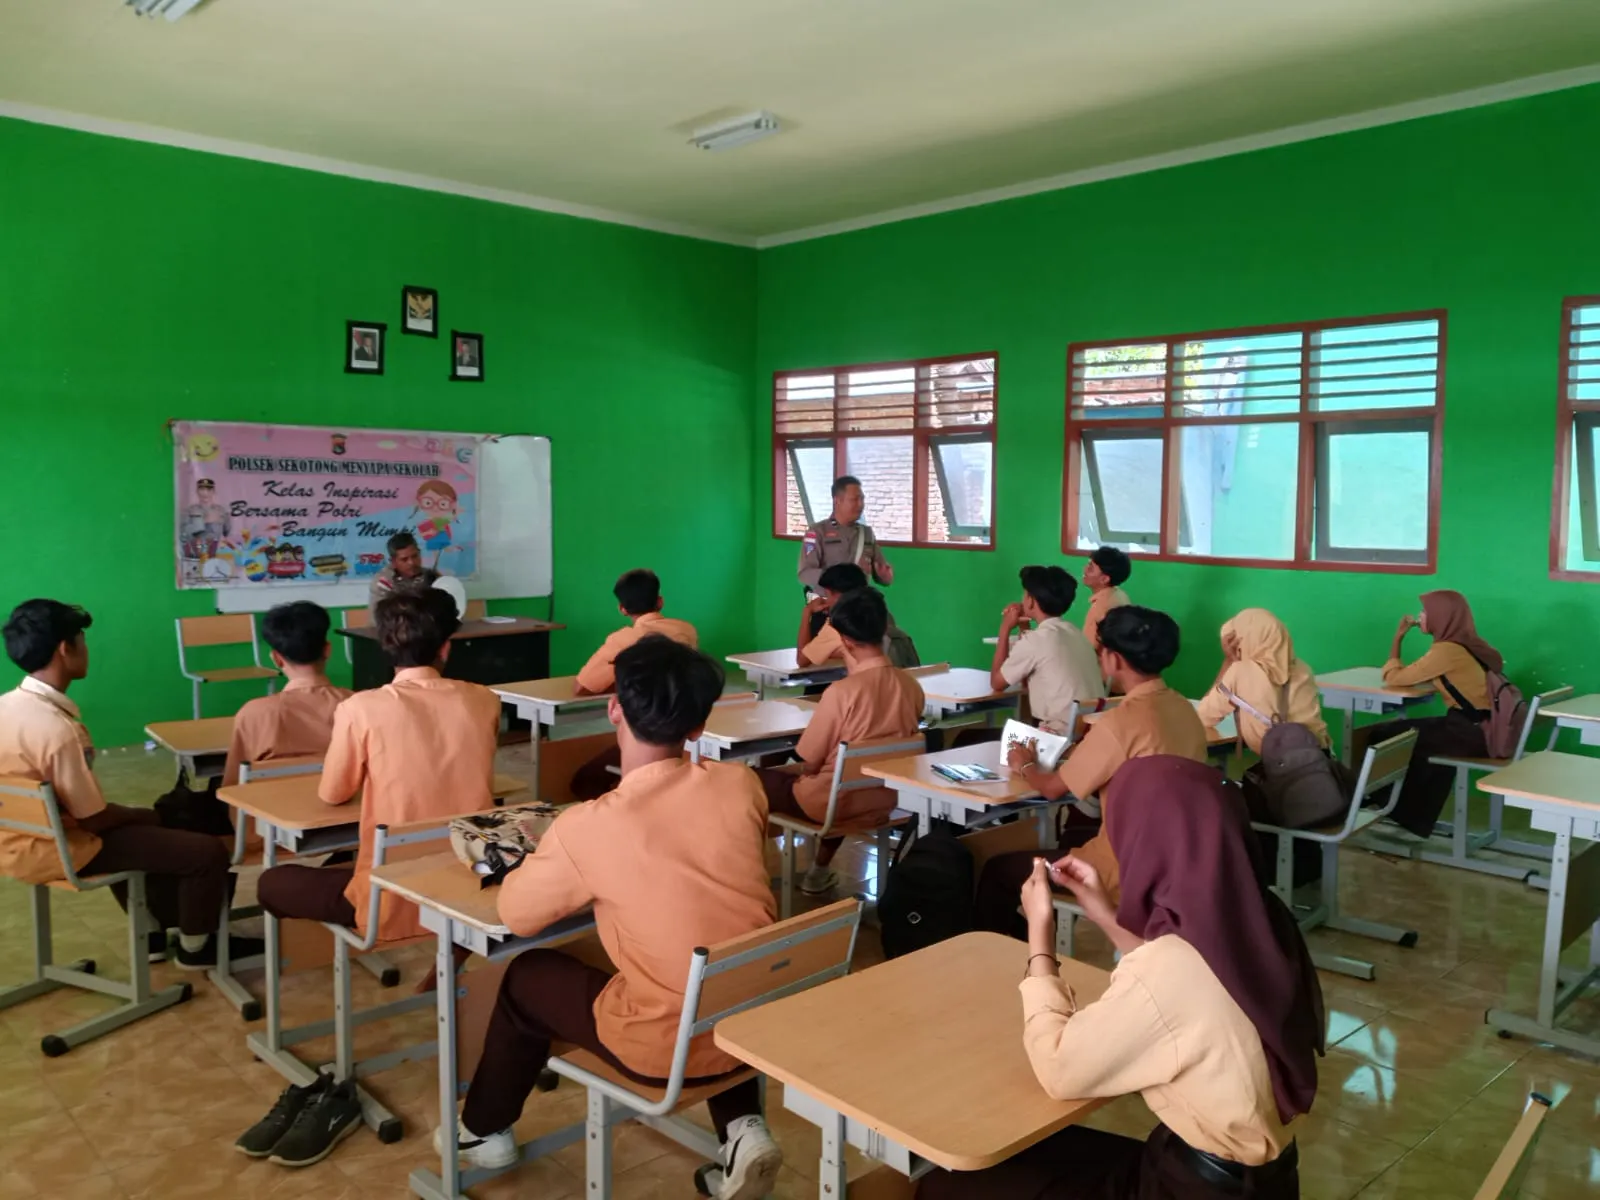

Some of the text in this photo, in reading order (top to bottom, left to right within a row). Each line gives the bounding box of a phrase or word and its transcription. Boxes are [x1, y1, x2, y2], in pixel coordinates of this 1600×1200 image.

[228, 457, 440, 477] POLSEK SEKOTONG MENYAPA SEKOLAH
[262, 480, 399, 503] Kelas Inspirasi
[230, 500, 363, 518] Bersama Polri
[282, 520, 348, 540] Bangun
